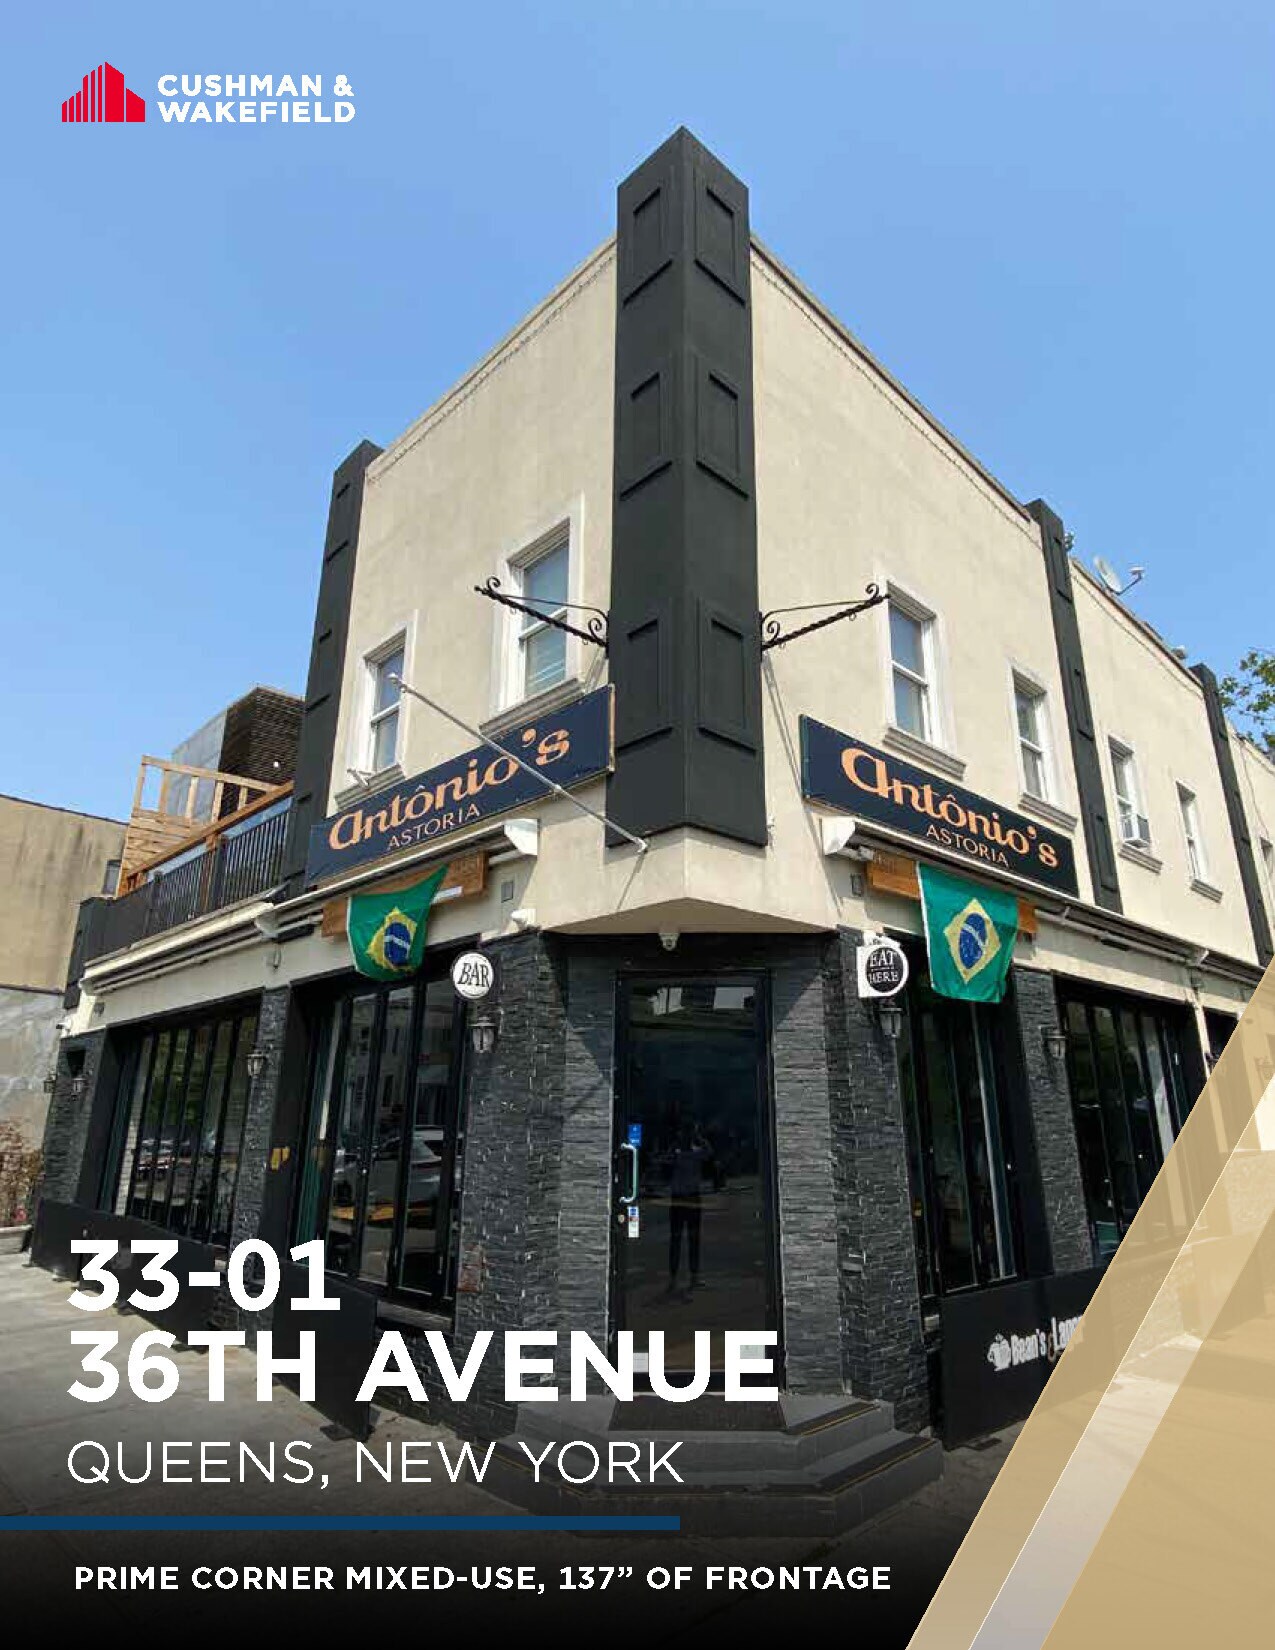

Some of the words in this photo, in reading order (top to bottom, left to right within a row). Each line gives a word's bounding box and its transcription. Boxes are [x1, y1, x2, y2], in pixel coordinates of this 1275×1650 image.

[329, 728, 571, 850] Antônio's
[841, 747, 1059, 868] Antônio's
[387, 803, 480, 851] ASTORIA
[926, 824, 1009, 868] ASTORIA
[457, 961, 490, 987] BAR
[868, 971, 899, 984] HERE
[869, 948, 897, 967] EAT
